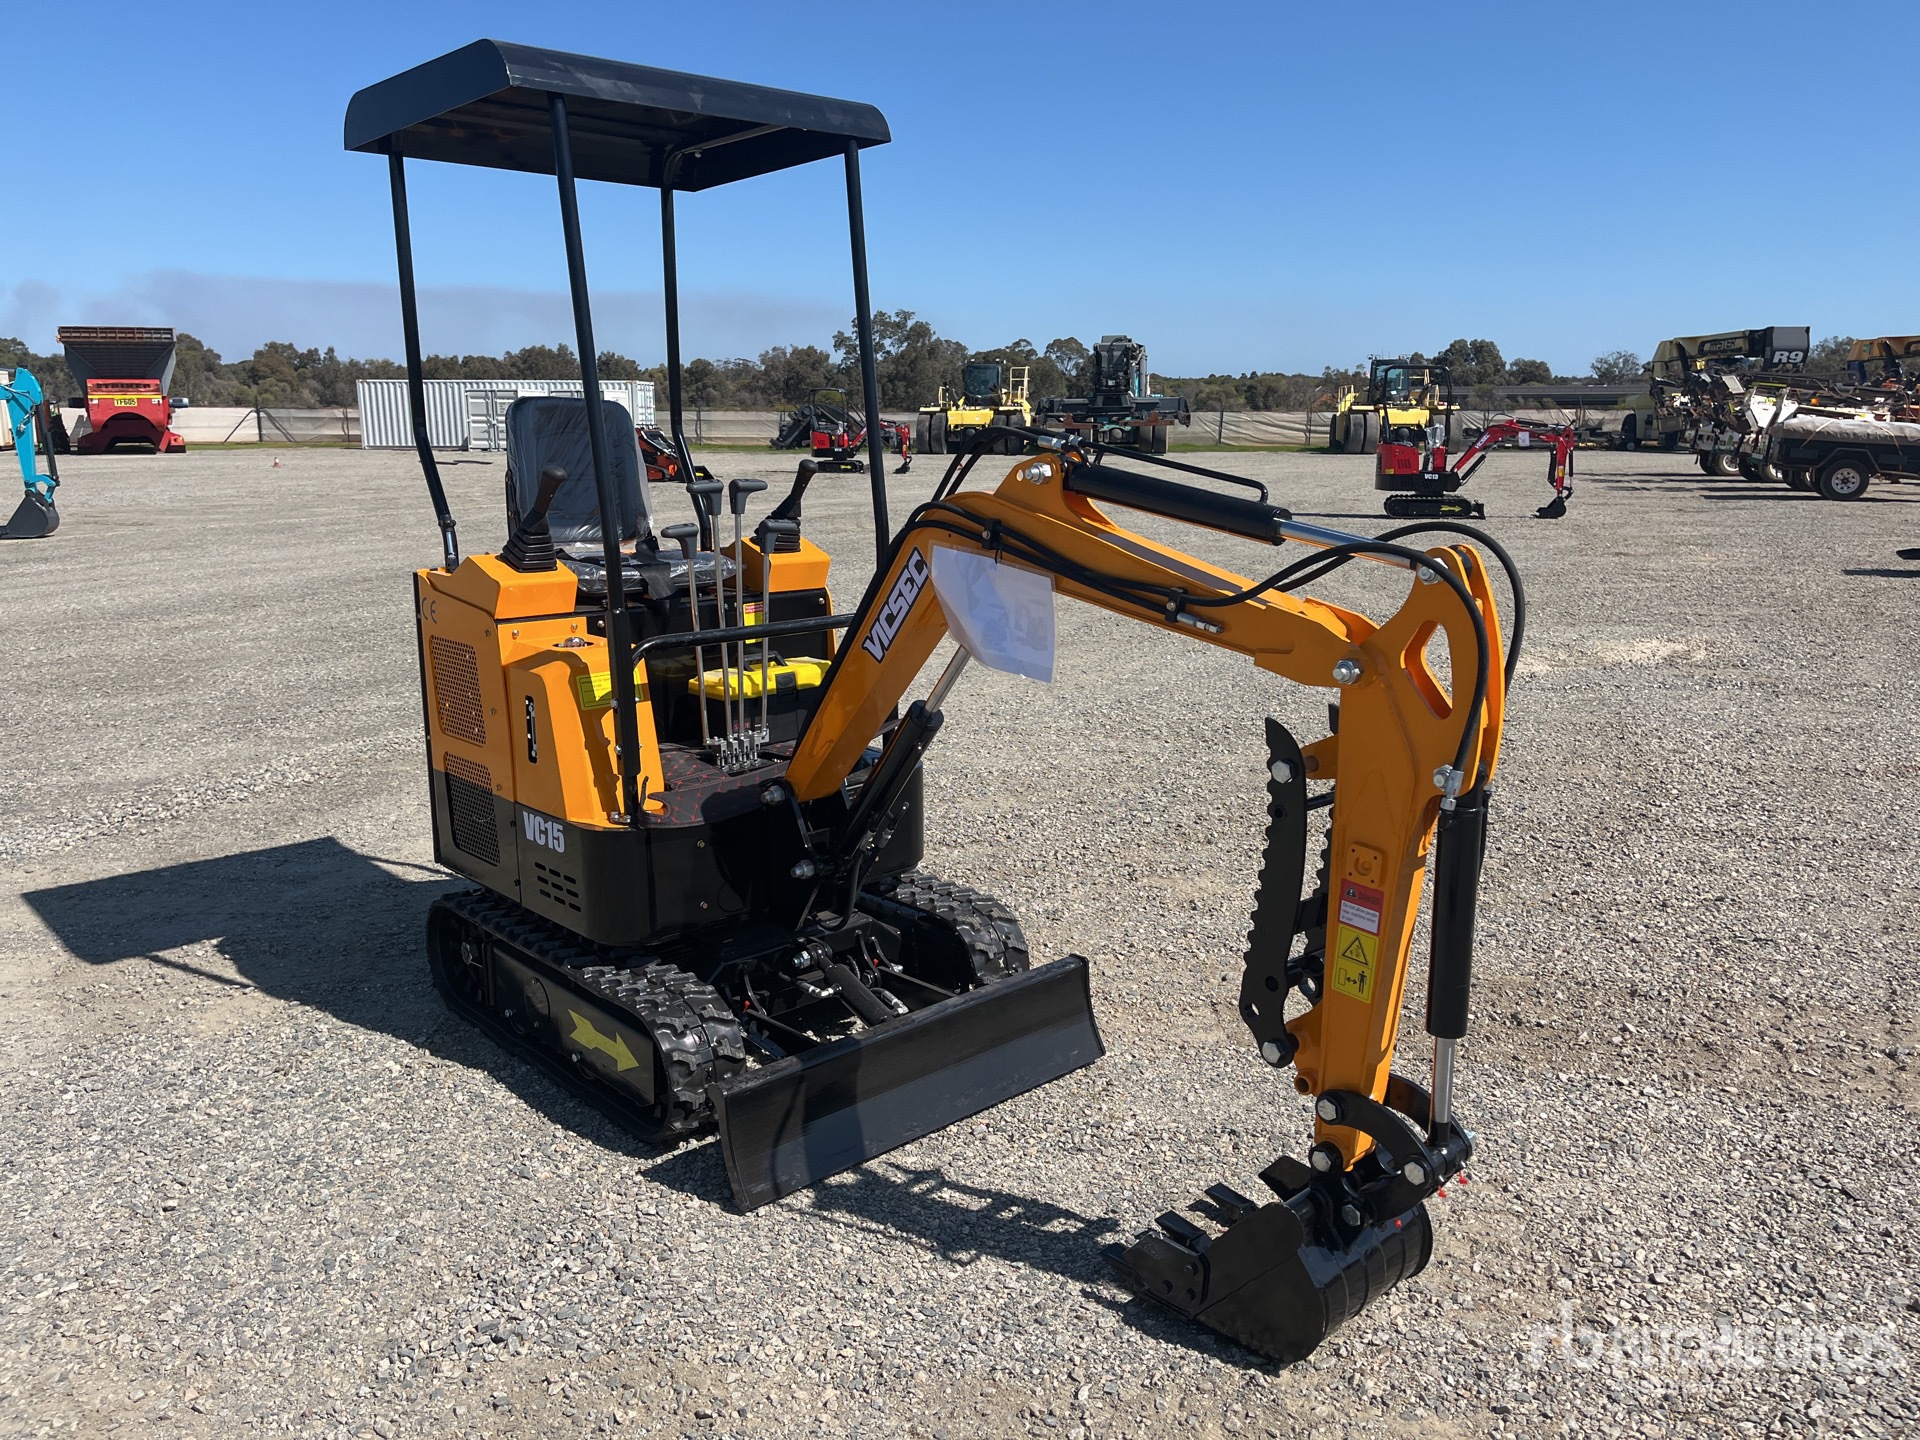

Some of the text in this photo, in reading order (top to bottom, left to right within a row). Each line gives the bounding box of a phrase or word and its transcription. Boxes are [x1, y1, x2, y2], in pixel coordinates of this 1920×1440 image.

[1772, 351, 1804, 363] R9
[422, 596, 437, 625] CE
[863, 547, 929, 662] VICSEC
[523, 811, 565, 854] VC15
